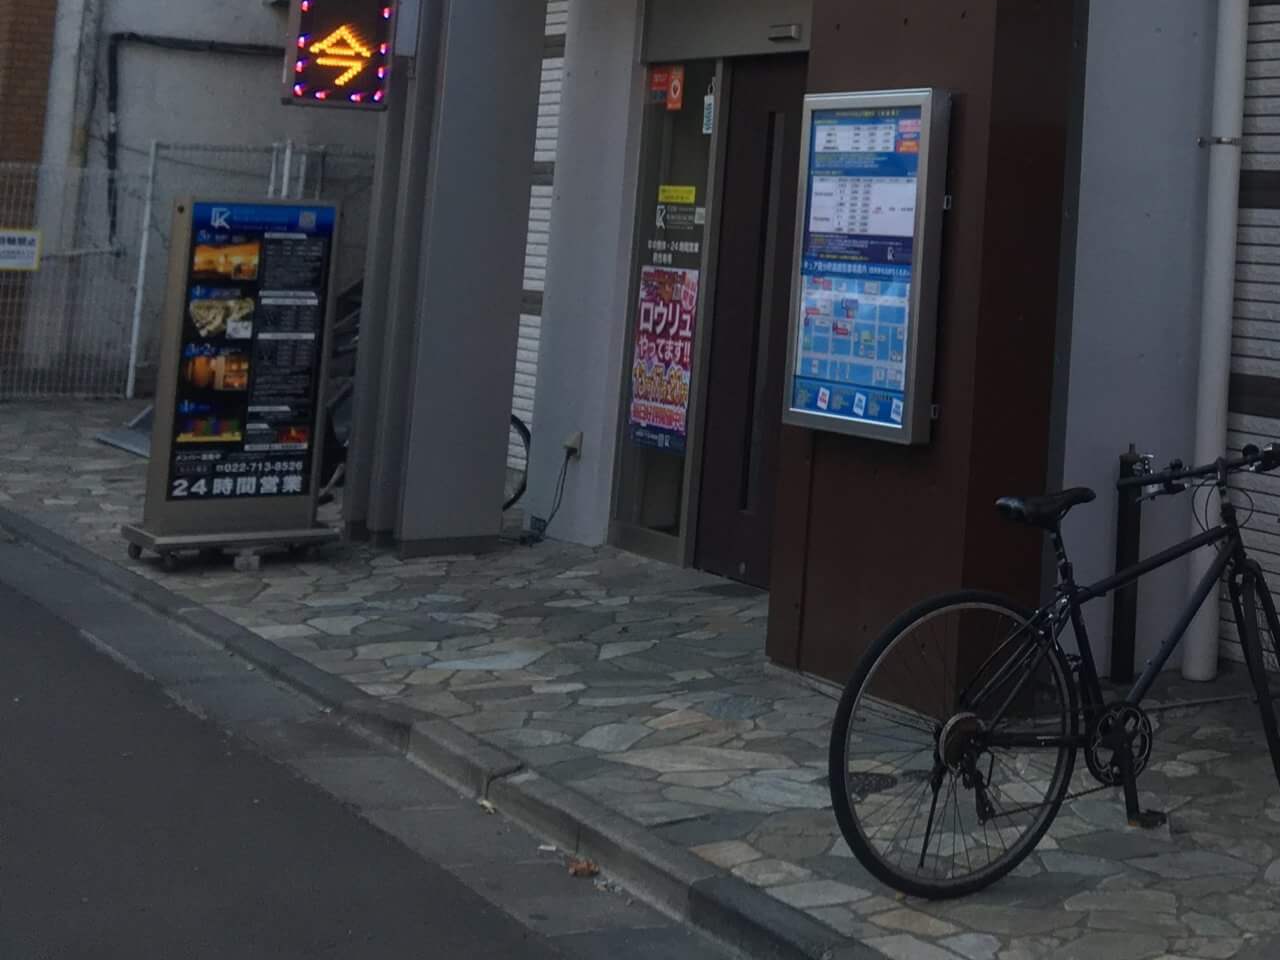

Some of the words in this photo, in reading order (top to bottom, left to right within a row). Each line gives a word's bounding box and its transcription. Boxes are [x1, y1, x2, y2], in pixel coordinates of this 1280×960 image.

[639, 300, 693, 337] ロウリュ
[172, 476, 303, 497] 24時間営業
